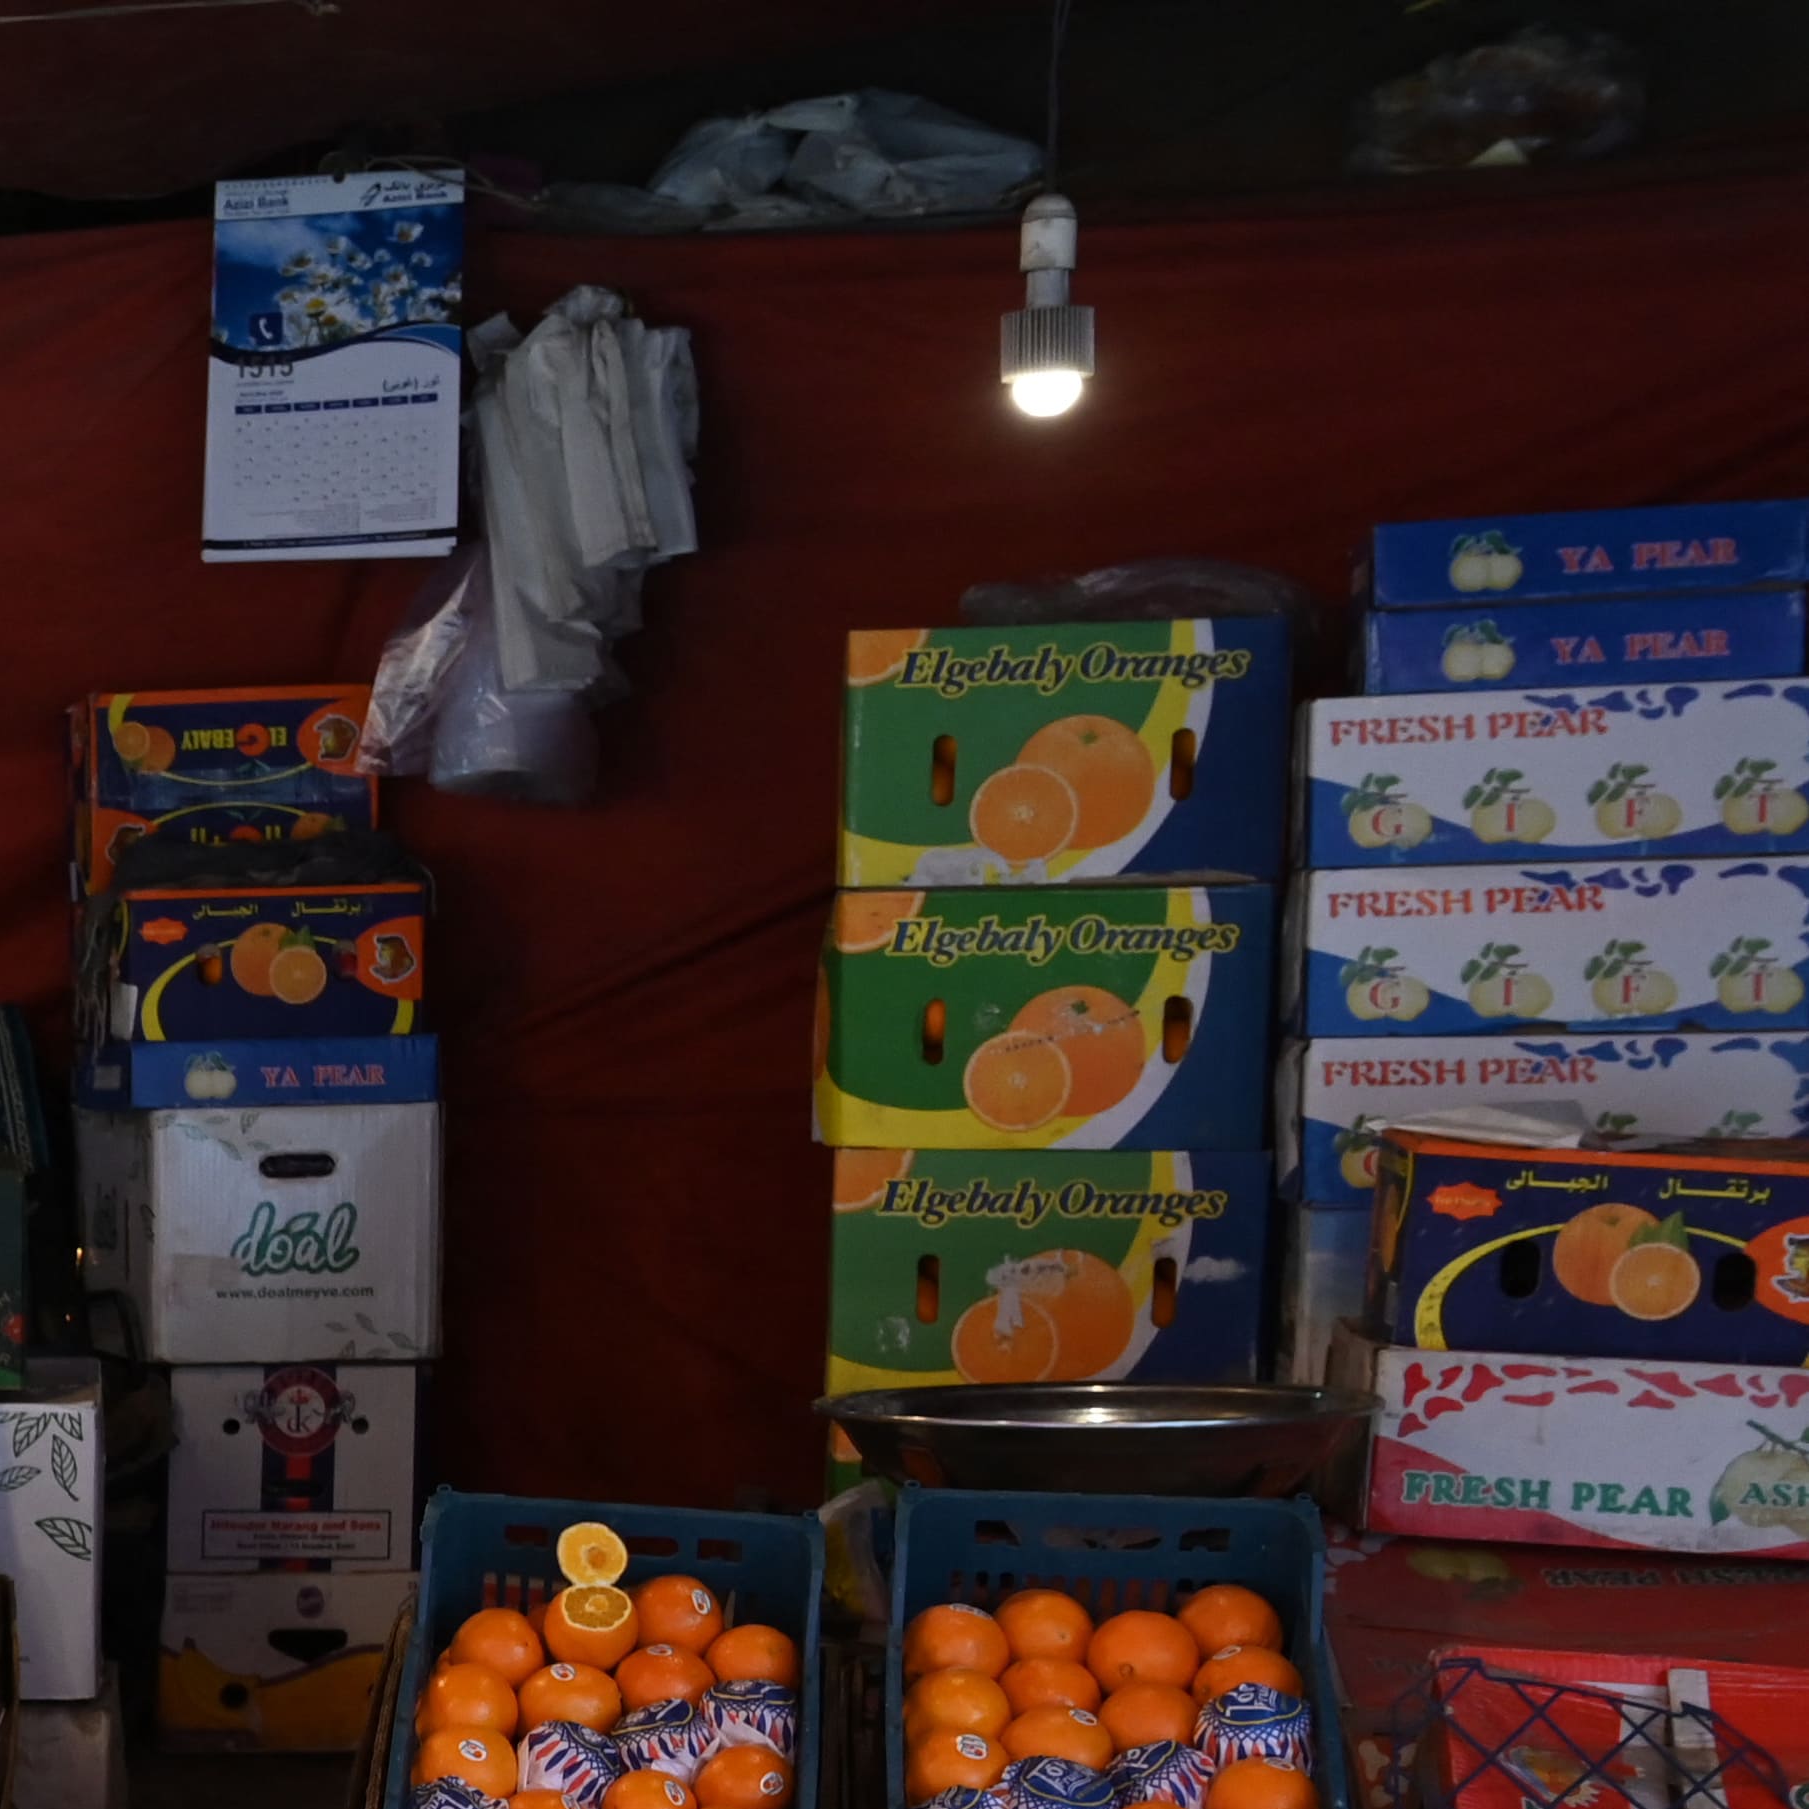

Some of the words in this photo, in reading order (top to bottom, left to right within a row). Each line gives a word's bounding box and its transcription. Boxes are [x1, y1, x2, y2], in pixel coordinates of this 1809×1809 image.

[1557, 546, 1614, 574] YA
[1631, 537, 1740, 570] PEAR
[1550, 636, 1606, 665] YA
[1624, 629, 1731, 661] PEAR
[900, 643, 1072, 696] Elgebaly
[1081, 643, 1252, 687] Oranges
[1330, 714, 1476, 746] FRESH
[1487, 707, 1609, 740] PEAR
[1328, 887, 1474, 919] FRESH
[1486, 884, 1604, 915] PEAR
[887, 914, 1064, 966] Elgebaly
[1070, 914, 1239, 960] Oranges
[260, 1066, 300, 1088] YA
[313, 1064, 388, 1087] PEAR
[1322, 1059, 1466, 1088] FRESH
[1479, 1056, 1599, 1086] PEAR
[879, 1177, 1053, 1227] Elgebaly
[1058, 1180, 1229, 1227] Oranges
[1401, 1470, 1552, 1510] FRESH
[1570, 1481, 1694, 1518] PEAR
